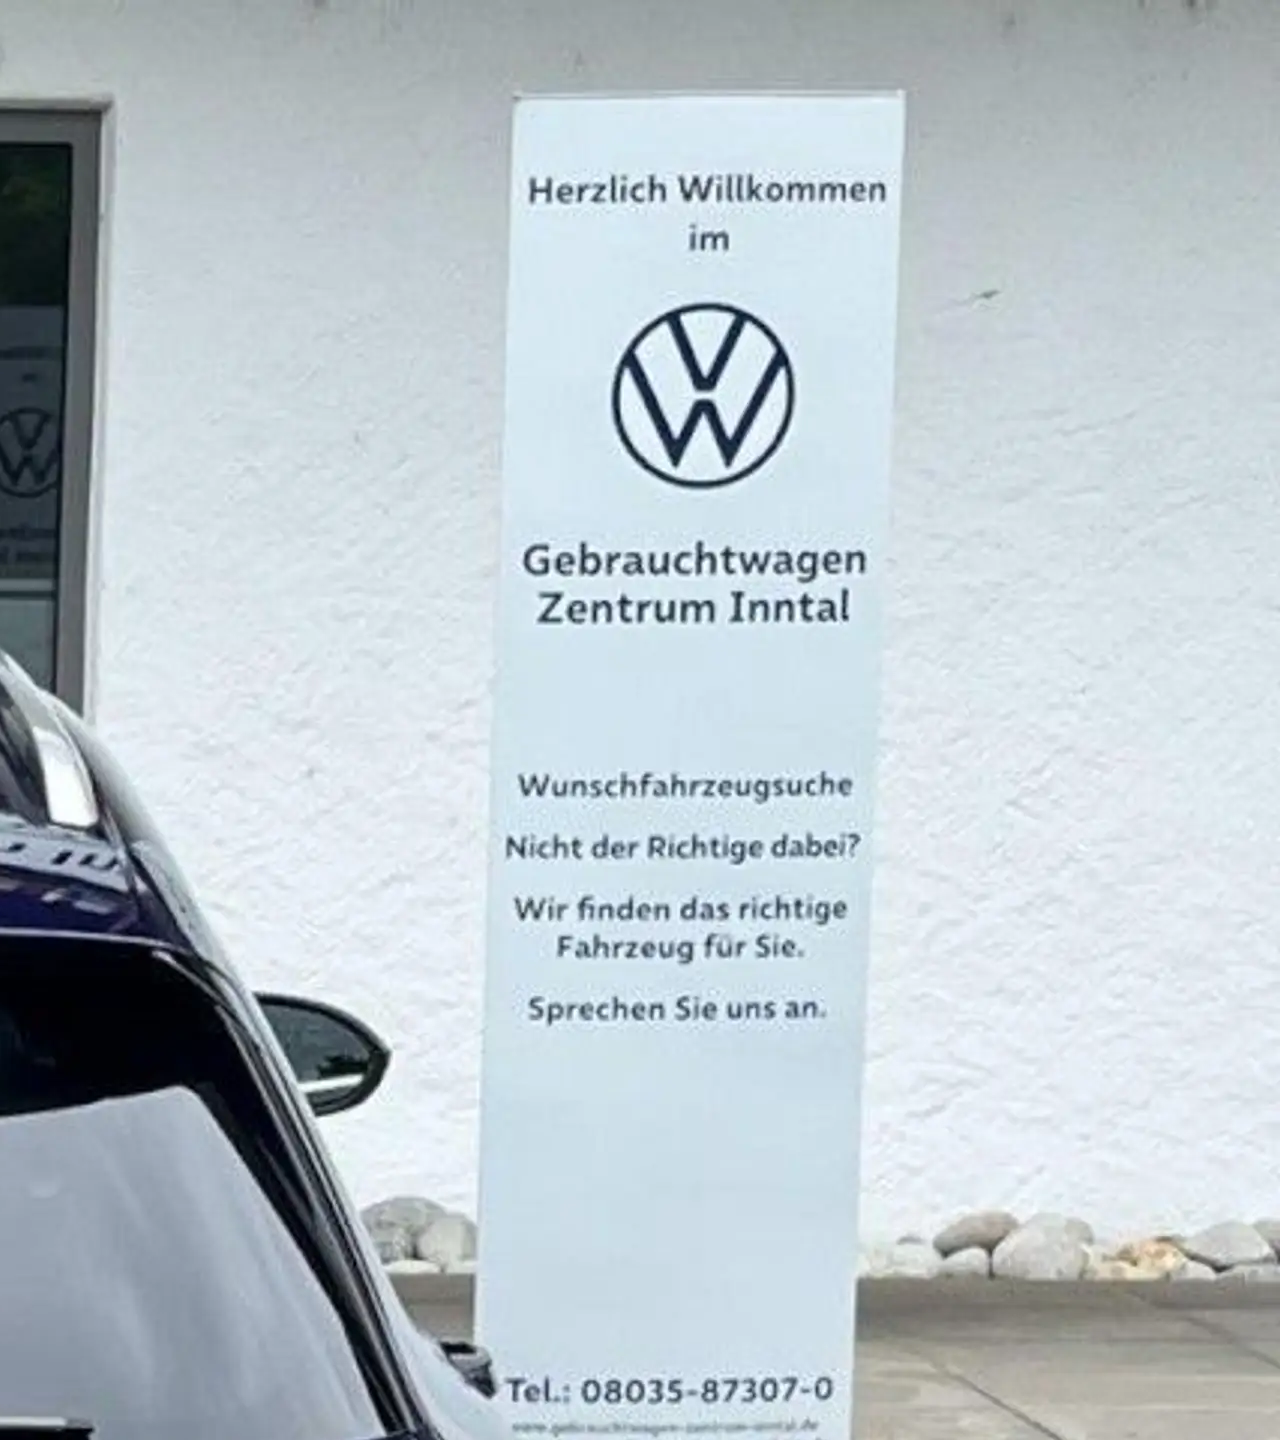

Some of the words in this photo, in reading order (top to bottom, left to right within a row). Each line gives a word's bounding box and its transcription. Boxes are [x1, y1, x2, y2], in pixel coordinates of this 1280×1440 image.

[528, 173, 667, 205] Herzlich
[677, 173, 887, 203] Willkommen
[689, 223, 730, 252] im
[522, 540, 867, 584] Gebrauchtwagen
[536, 591, 716, 625] Zentrum
[729, 587, 850, 623] Inntal
[517, 770, 854, 805] Wunschfahrzeugsuche
[505, 833, 583, 861] Nicht
[590, 833, 640, 860] der
[646, 832, 764, 866] Richtige
[770, 832, 862, 859] dabei?
[513, 896, 570, 922] Wir
[576, 895, 671, 922] finden
[679, 895, 731, 922] das
[738, 894, 848, 927] richtige
[556, 933, 695, 966] Fahrzeug
[703, 932, 748, 959] für
[755, 933, 804, 959] Sie.
[527, 995, 666, 1027] Sprechen
[674, 995, 718, 1022] Sie
[726, 1000, 777, 1021] uns
[784, 1000, 827, 1019] an.
[506, 1378, 571, 1402] Tel.:
[581, 1376, 834, 1403] 08035-87307-0
